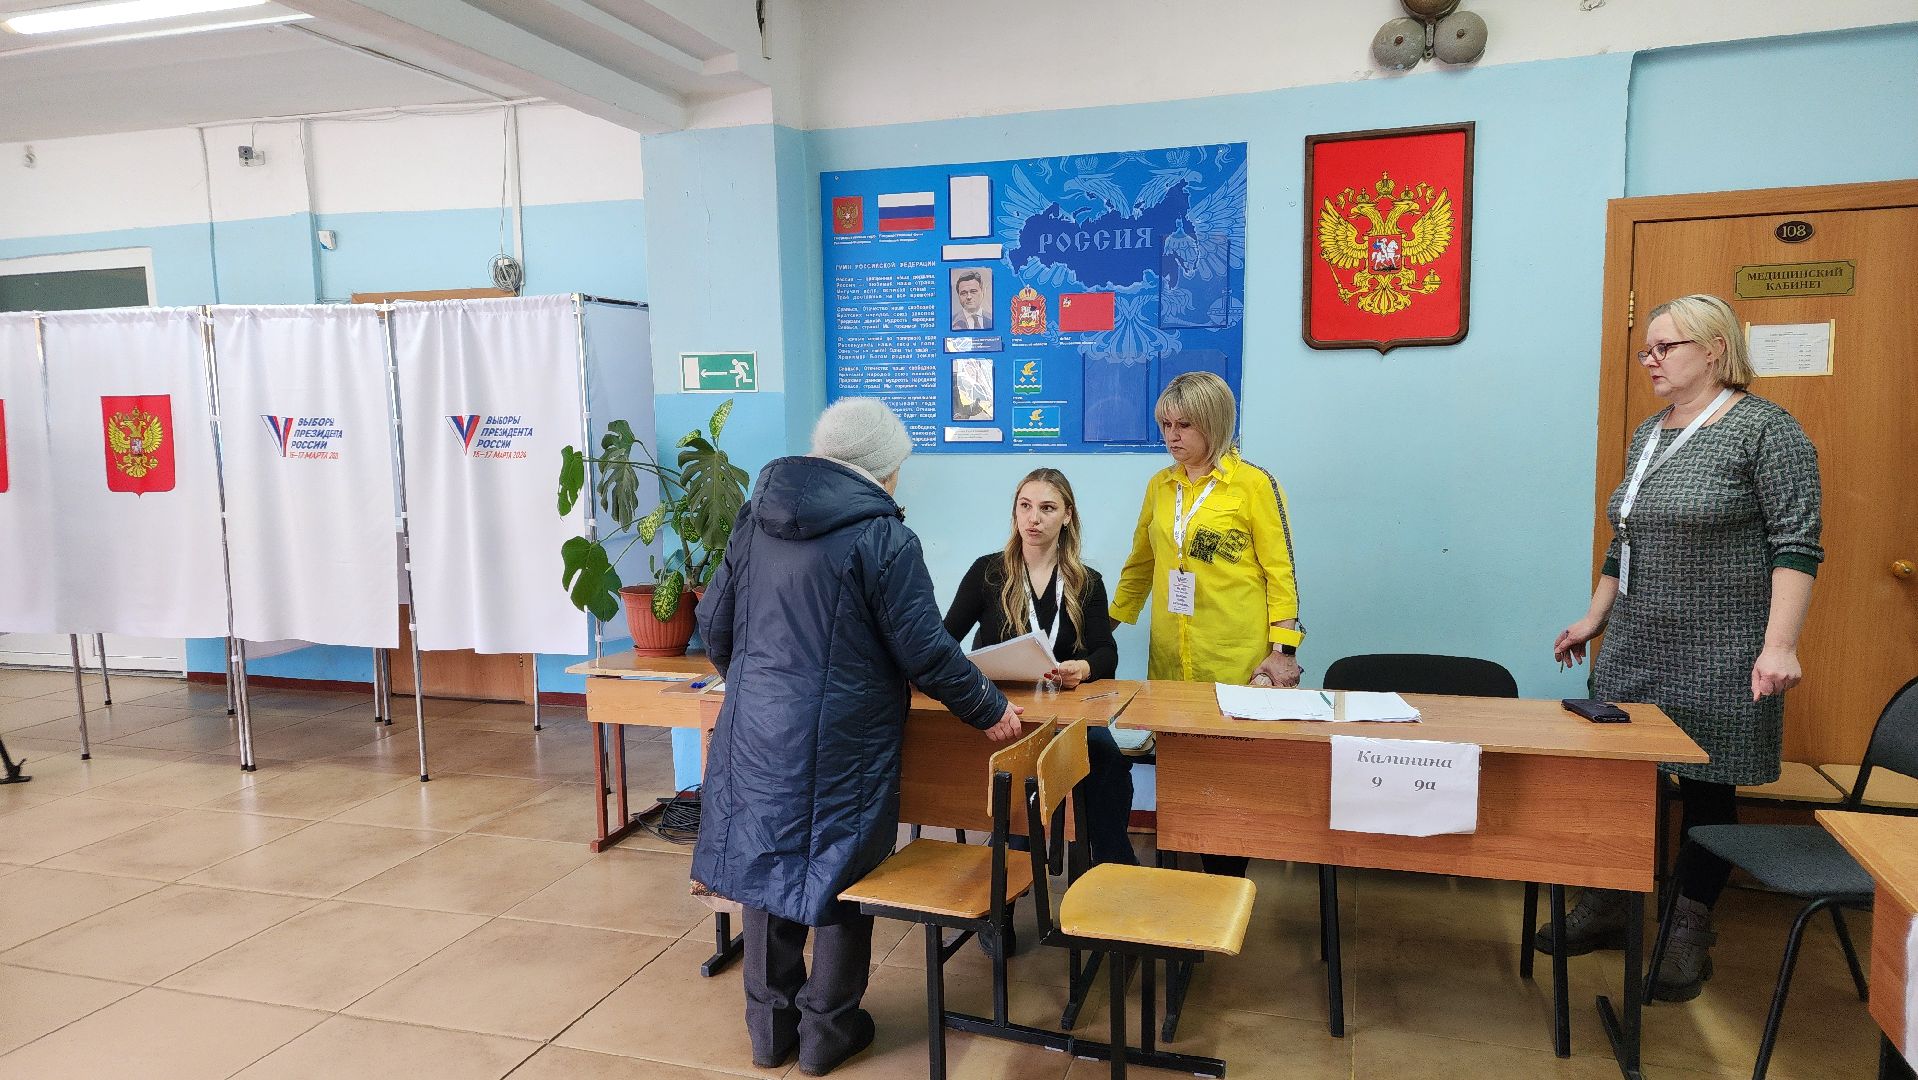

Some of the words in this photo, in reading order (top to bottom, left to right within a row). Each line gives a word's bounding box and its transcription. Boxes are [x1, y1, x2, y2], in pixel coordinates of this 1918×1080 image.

[1782, 225, 1807, 238] 108
[1038, 227, 1153, 254] РОССИЯ
[1747, 267, 1844, 281] МЕДИЦИНСКИЙ
[1766, 280, 1823, 291] КАБИНЕТ
[485, 416, 521, 424] ВЫБОРЫ
[480, 428, 533, 438] ПРЕЗИДЕНТА
[291, 441, 327, 449] РОССИИ
[476, 440, 511, 448] РОССИИ
[1357, 750, 1453, 768] Калинина
[1372, 776, 1383, 788] 9
[1415, 779, 1437, 791] 9а
